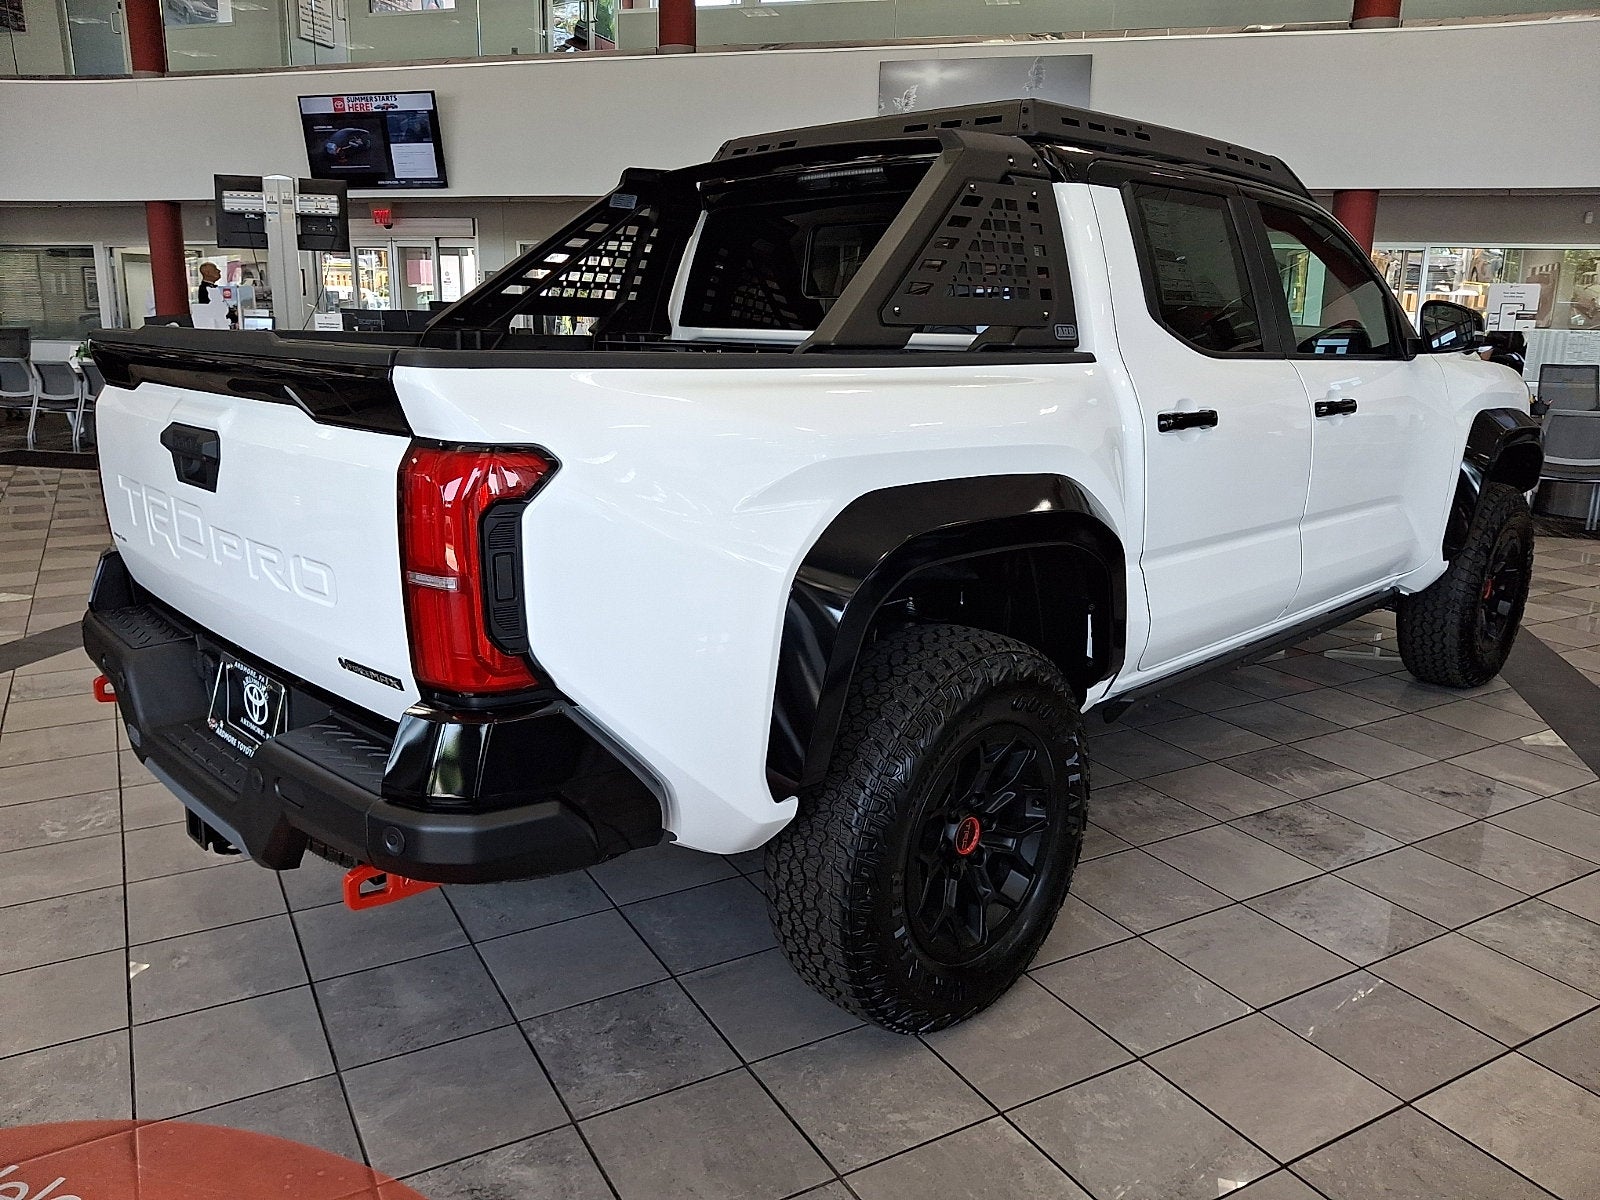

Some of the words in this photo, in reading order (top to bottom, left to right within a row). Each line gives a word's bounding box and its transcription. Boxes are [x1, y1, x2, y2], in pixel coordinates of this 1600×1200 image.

[348, 103, 374, 112] HERE!
[117, 474, 209, 559] TRD
[208, 525, 339, 608] PRO
[216, 727, 237, 746] ARDMORE
